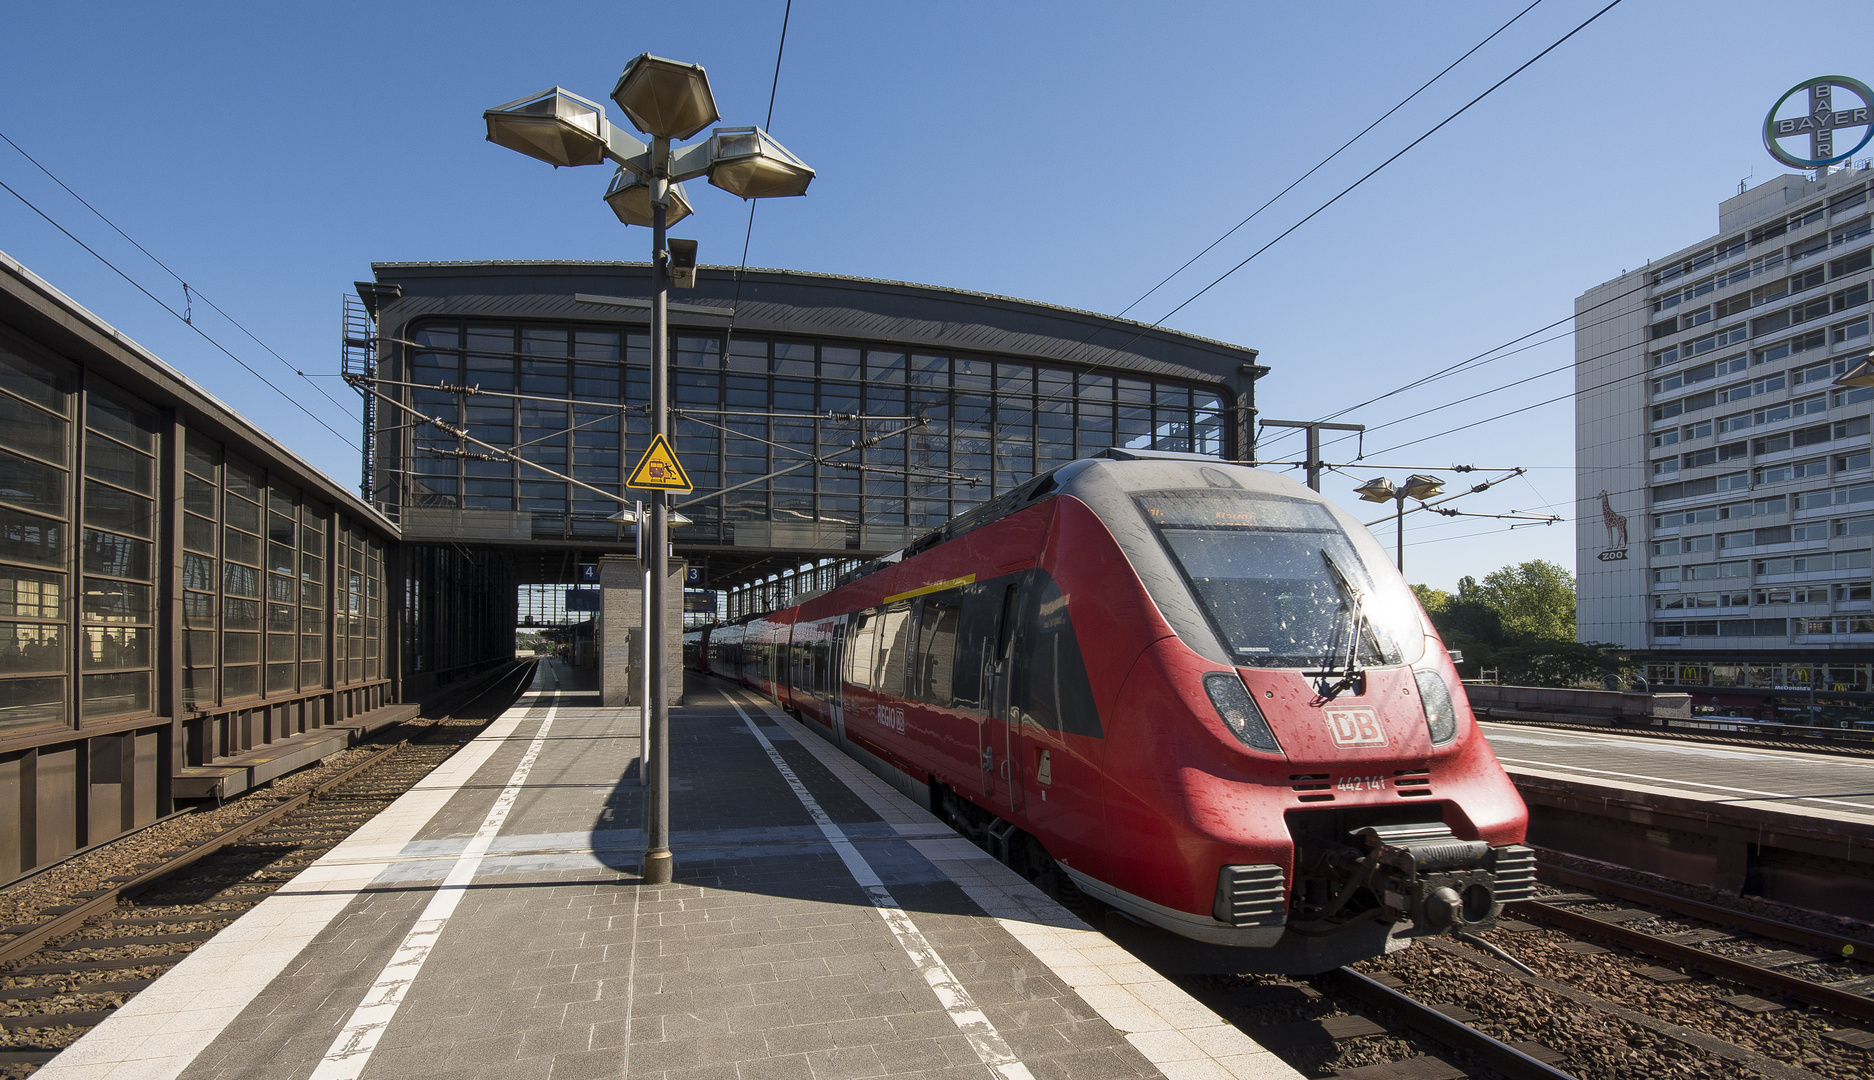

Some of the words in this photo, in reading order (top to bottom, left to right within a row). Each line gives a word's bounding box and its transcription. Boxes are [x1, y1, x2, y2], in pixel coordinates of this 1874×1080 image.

[1779, 108, 1869, 133] BAYER
[1815, 84, 1832, 157] BAYER
[1602, 551, 1623, 560] ZOO
[585, 566, 594, 577] 4
[690, 568, 698, 580] 3
[877, 704, 896, 729] REGIO
[896, 709, 905, 733] DB
[1332, 712, 1379, 741] DB
[1337, 776, 1363, 791] 442
[1365, 775, 1386, 790] 141
